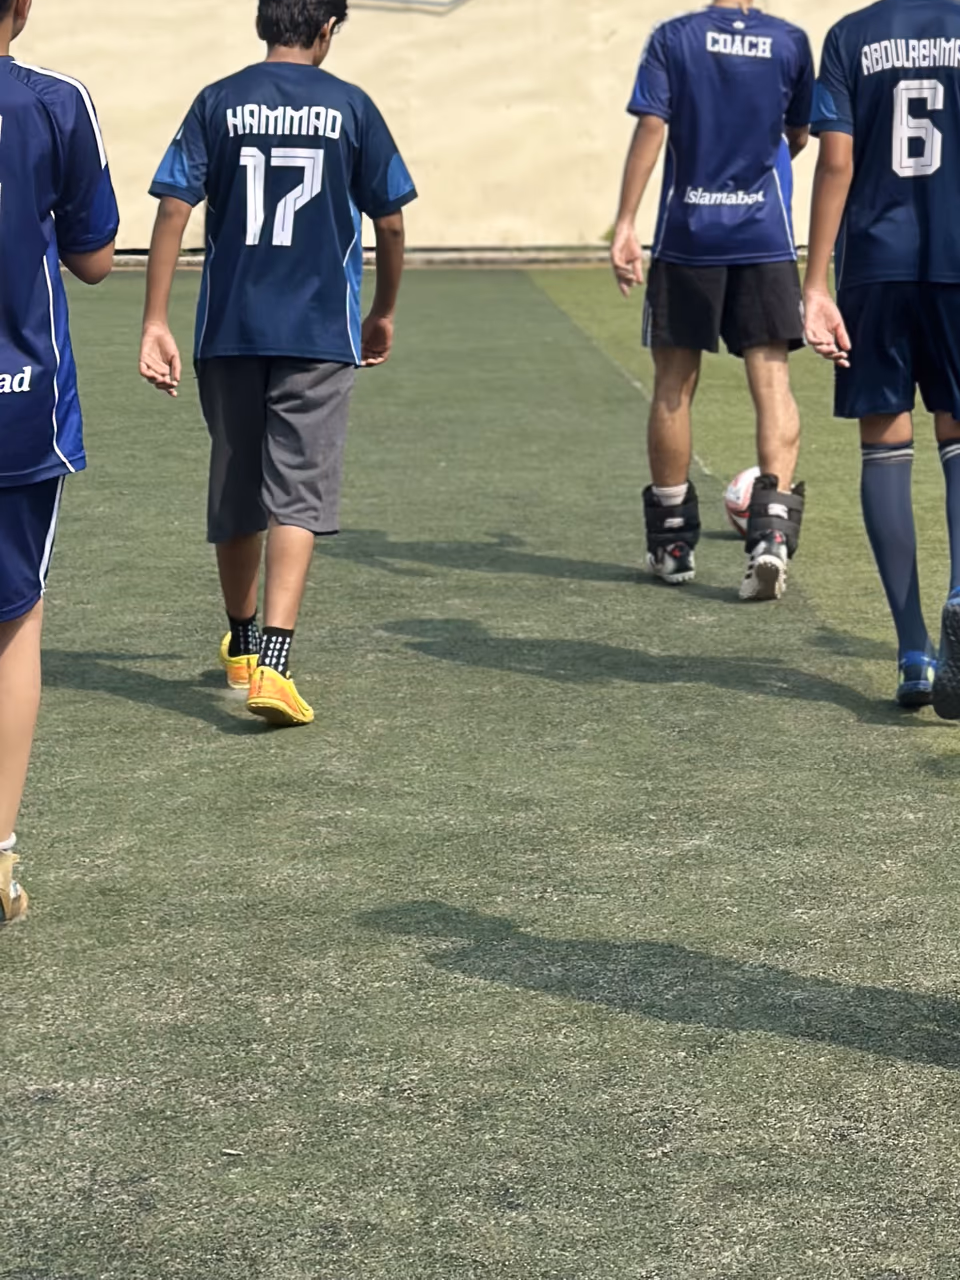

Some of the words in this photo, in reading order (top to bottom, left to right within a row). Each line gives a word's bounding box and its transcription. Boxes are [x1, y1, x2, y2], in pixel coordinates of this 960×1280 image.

[706, 31, 773, 58] COACH
[226, 103, 343, 140] HAMMAD
[892, 79, 944, 178] 6
[239, 146, 325, 247] 17
